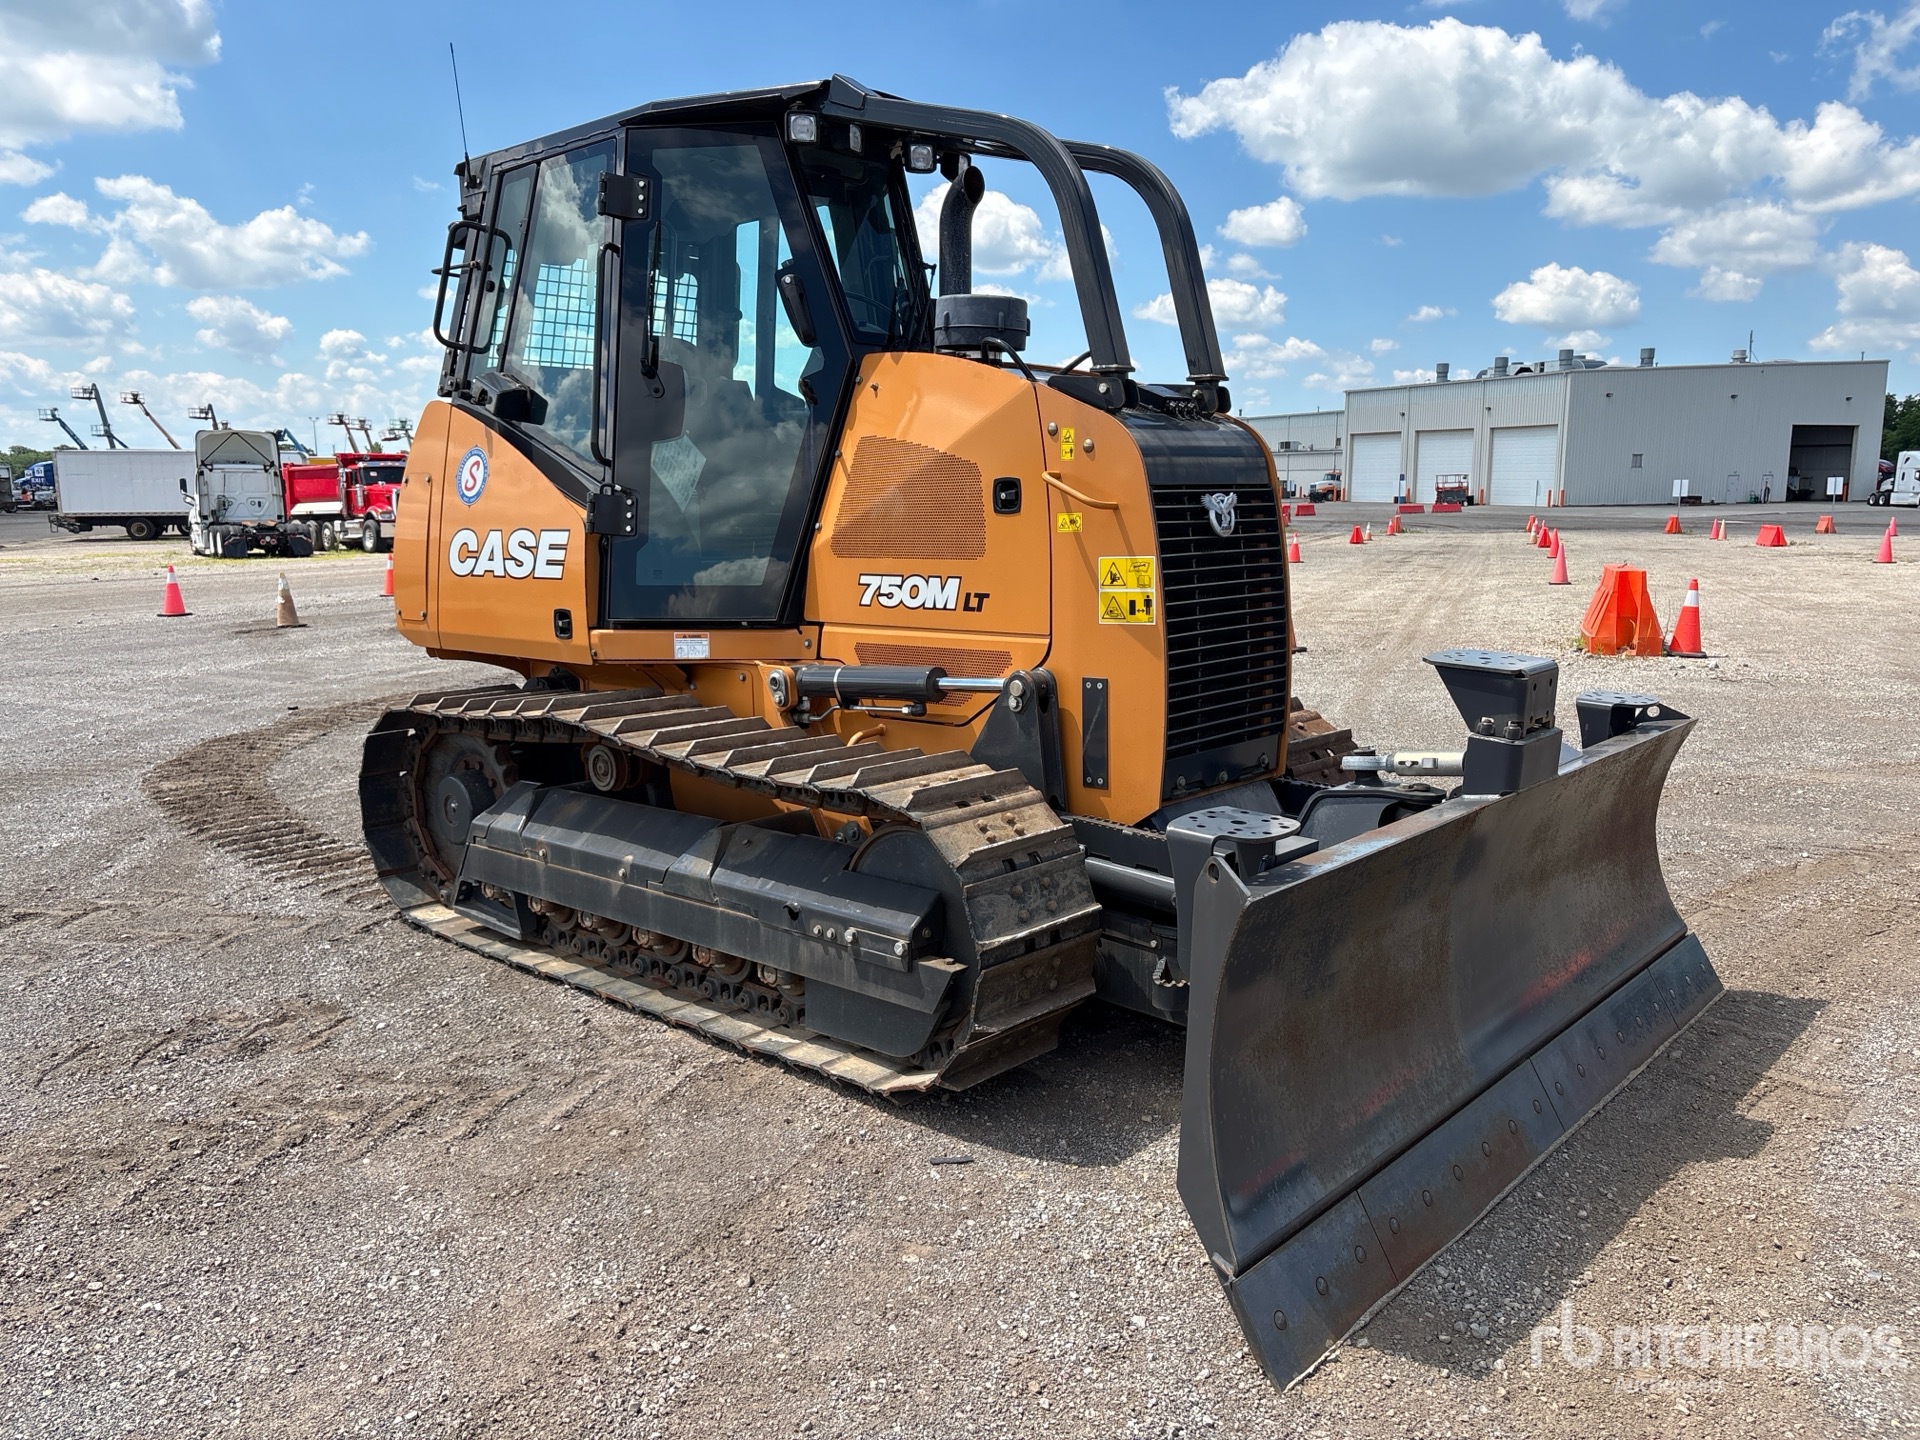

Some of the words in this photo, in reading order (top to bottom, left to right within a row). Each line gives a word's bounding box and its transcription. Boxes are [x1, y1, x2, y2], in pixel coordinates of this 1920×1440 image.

[464, 460, 481, 492] S
[448, 527, 571, 580] CASE
[858, 573, 962, 611] 750M
[963, 592, 990, 612] LT
